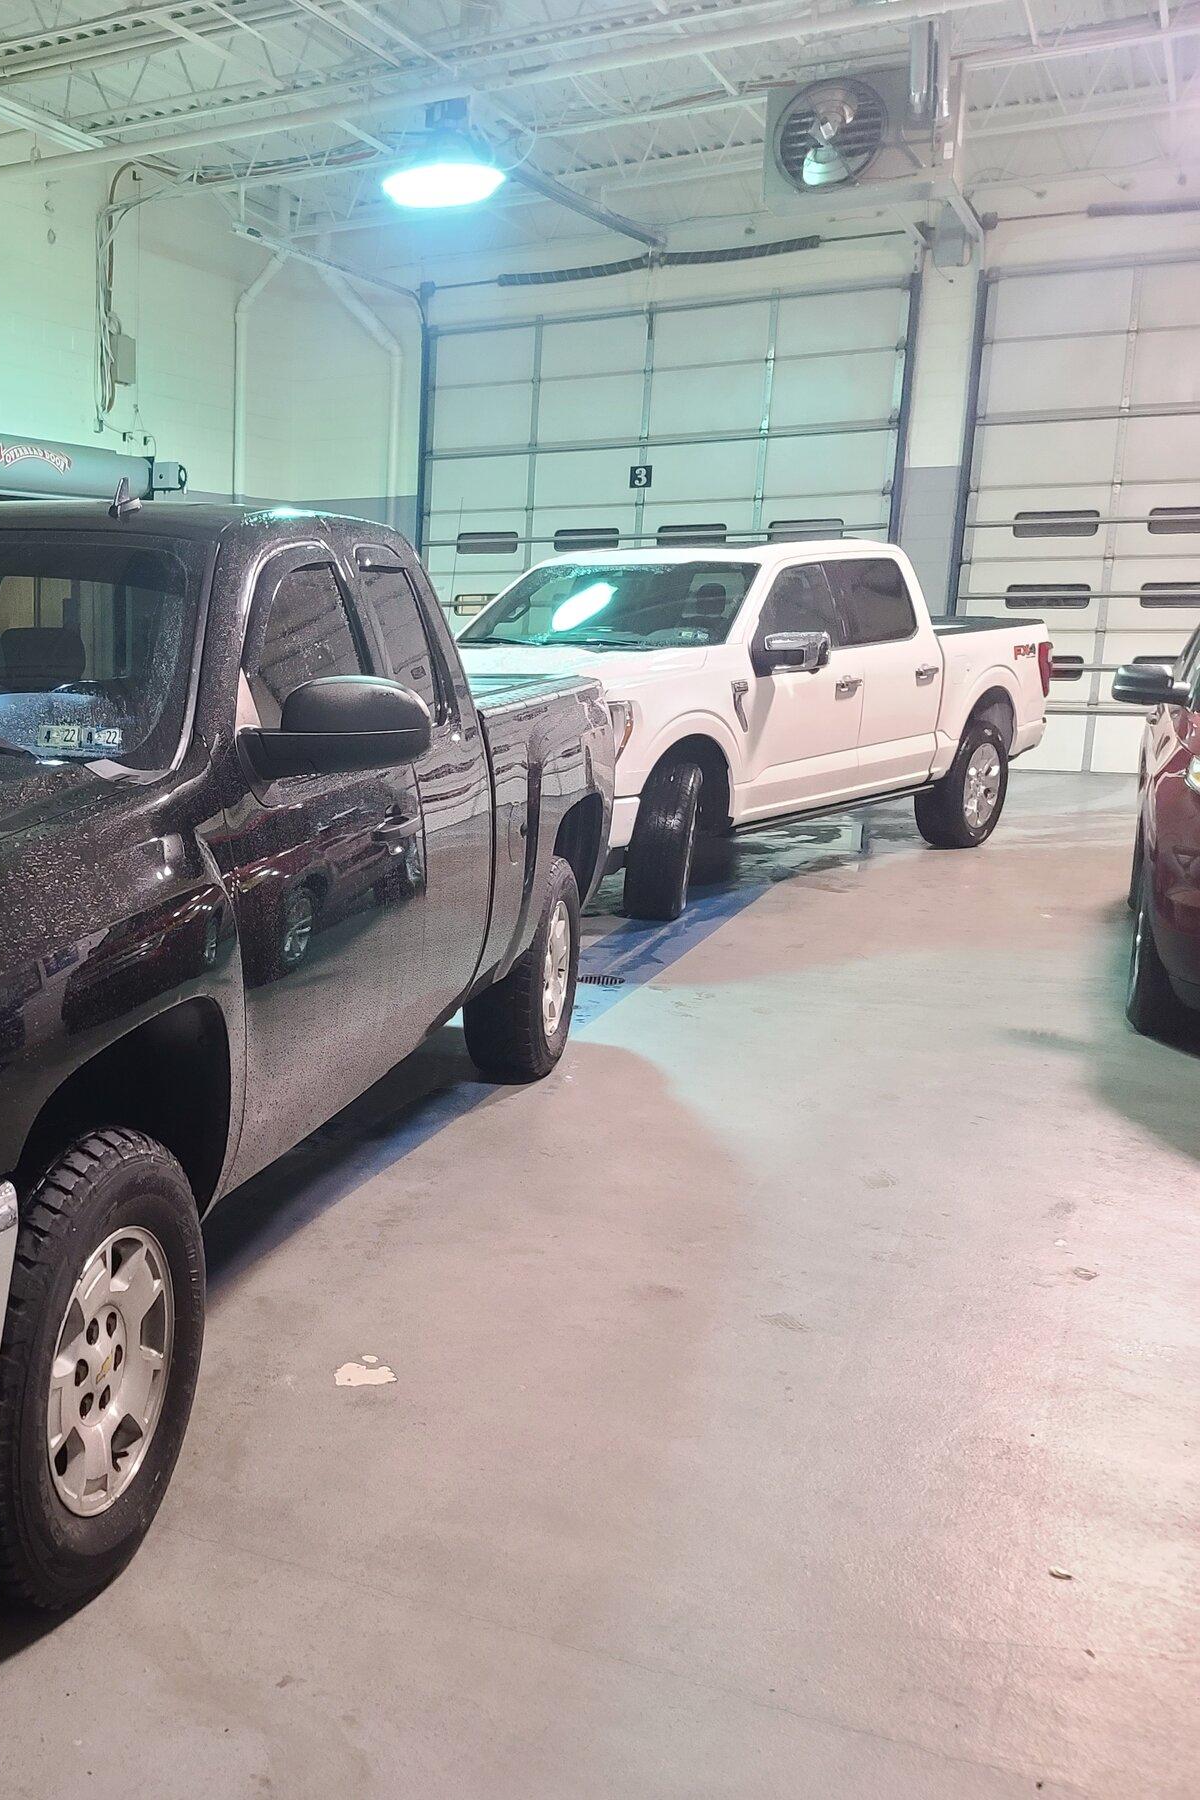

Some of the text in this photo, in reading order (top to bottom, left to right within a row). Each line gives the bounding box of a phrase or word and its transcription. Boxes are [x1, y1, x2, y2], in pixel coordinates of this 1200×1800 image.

[634, 467, 647, 486] 3
[1013, 643, 1036, 660] FX4
[63, 728, 76, 743] 22
[105, 730, 118, 745] 22
